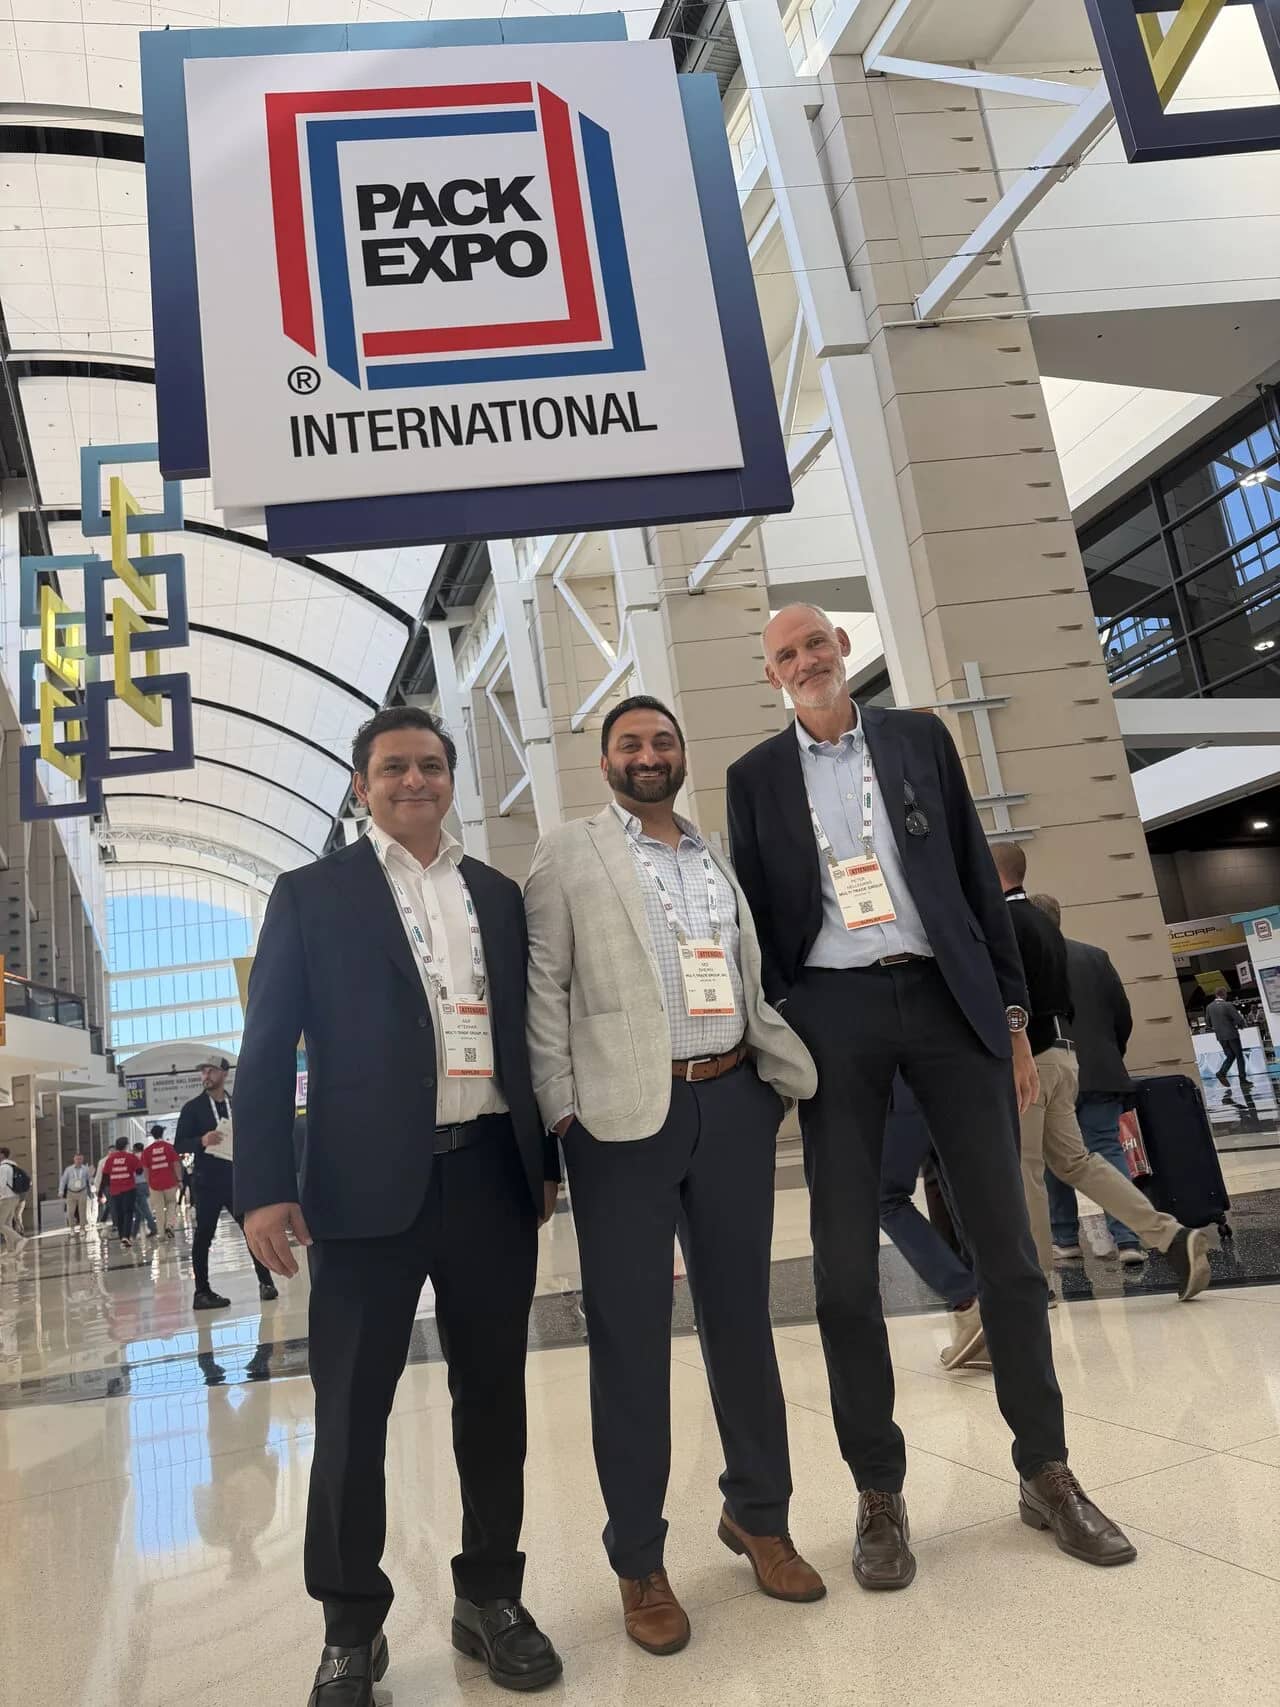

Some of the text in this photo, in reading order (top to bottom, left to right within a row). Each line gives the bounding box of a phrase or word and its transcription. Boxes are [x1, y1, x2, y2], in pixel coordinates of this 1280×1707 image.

[355, 175, 542, 231] PACK
[360, 230, 549, 287] EXPO
[289, 390, 659, 458] INTERNATIONAL
